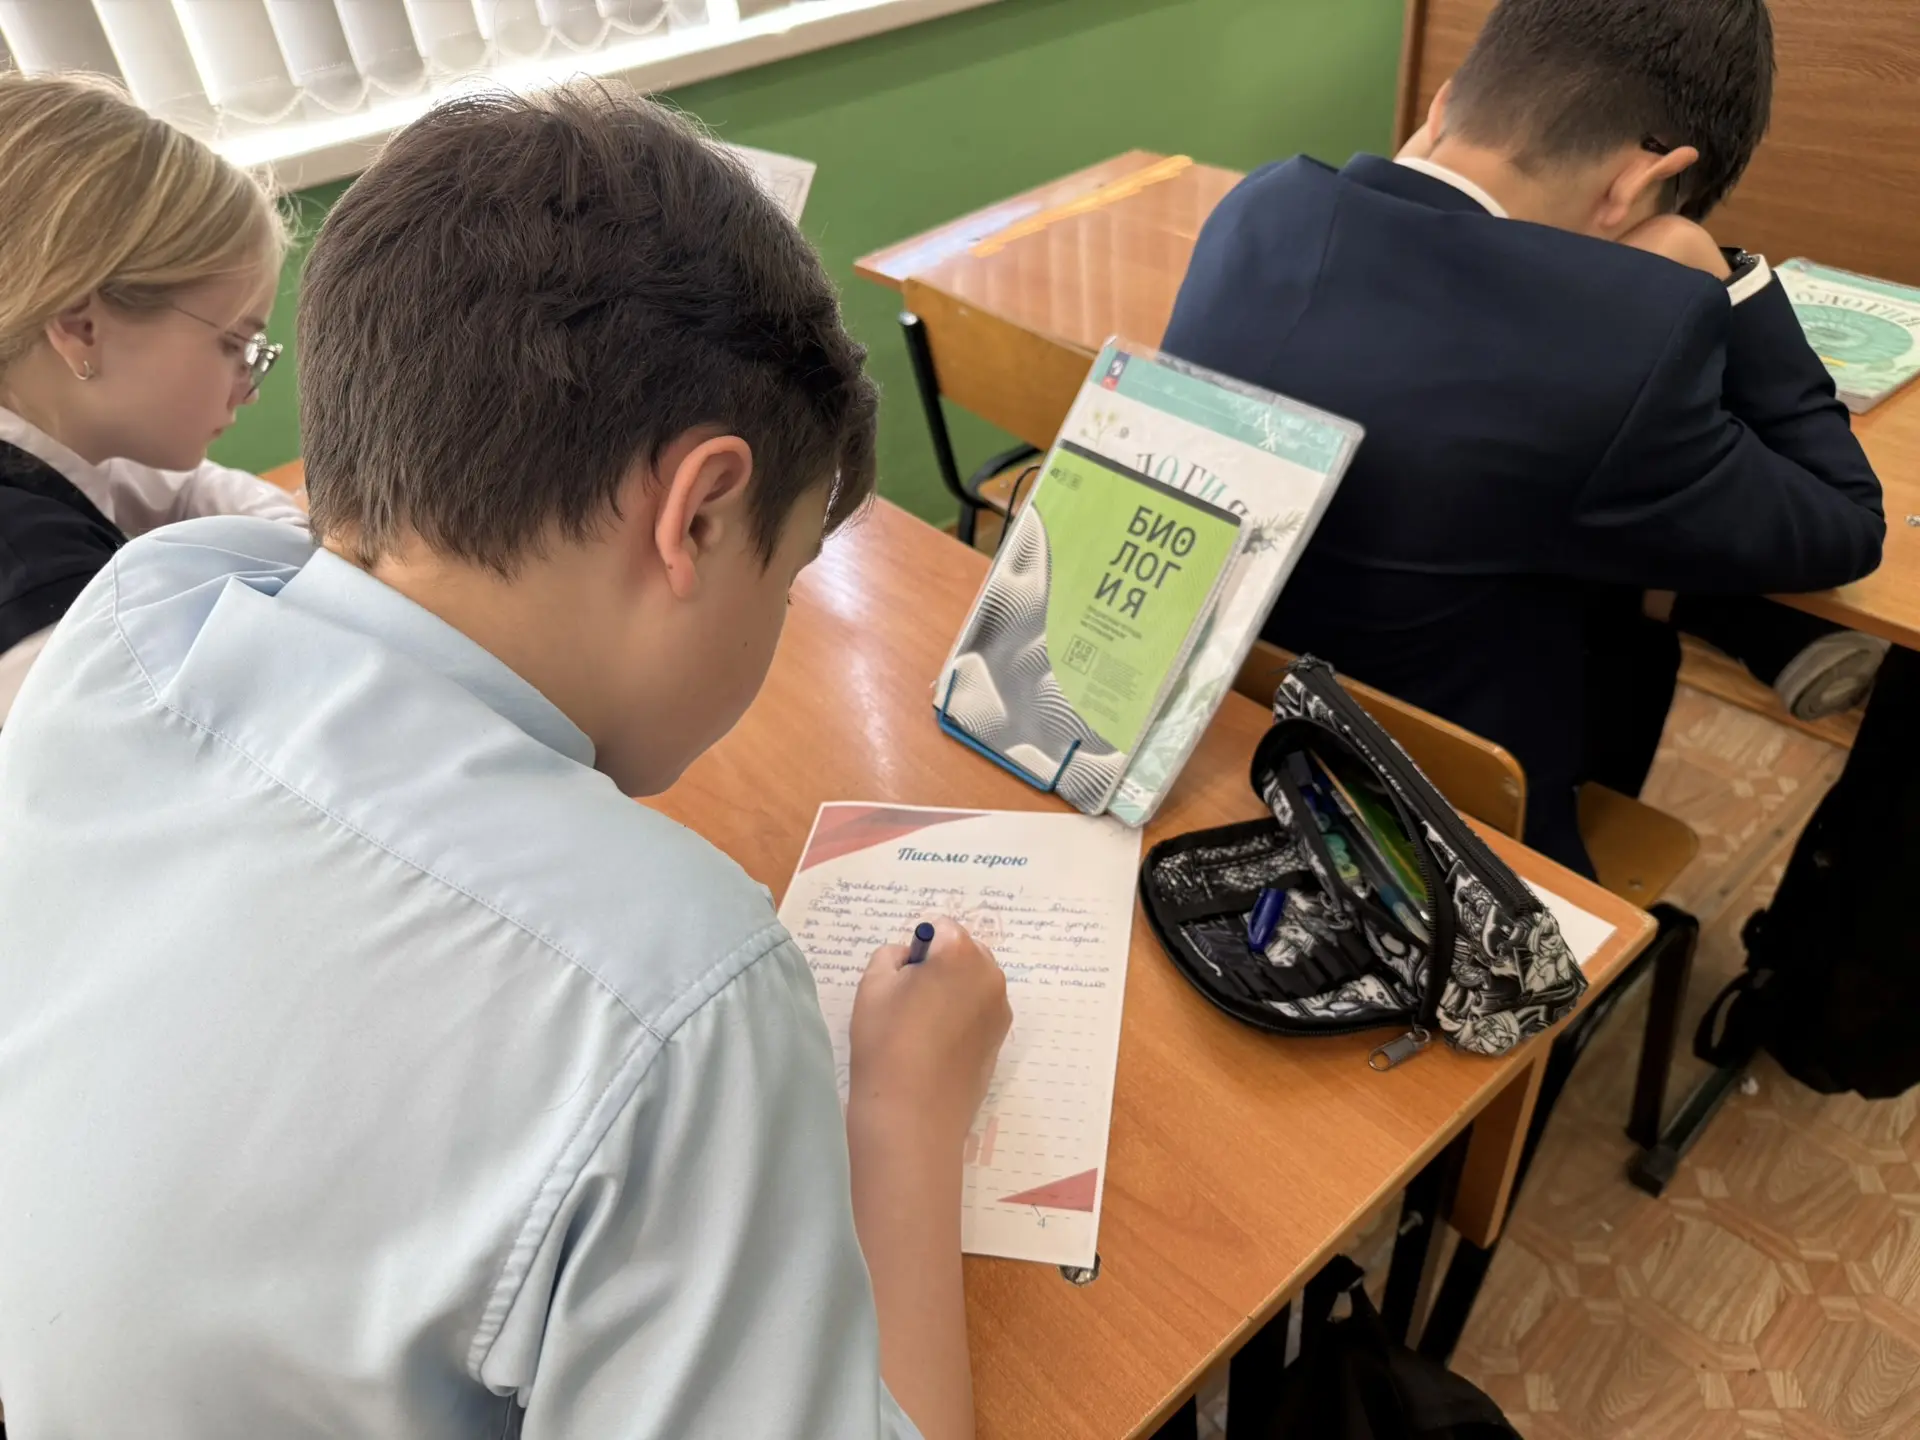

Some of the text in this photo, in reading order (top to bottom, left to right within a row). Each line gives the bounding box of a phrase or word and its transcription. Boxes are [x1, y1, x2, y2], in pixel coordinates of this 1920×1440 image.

[1127, 505, 1196, 557] БИО
[1109, 540, 1182, 589] ЛОГ
[1094, 572, 1148, 619] ИЯ
[897, 847, 1029, 868] Письмо герою
